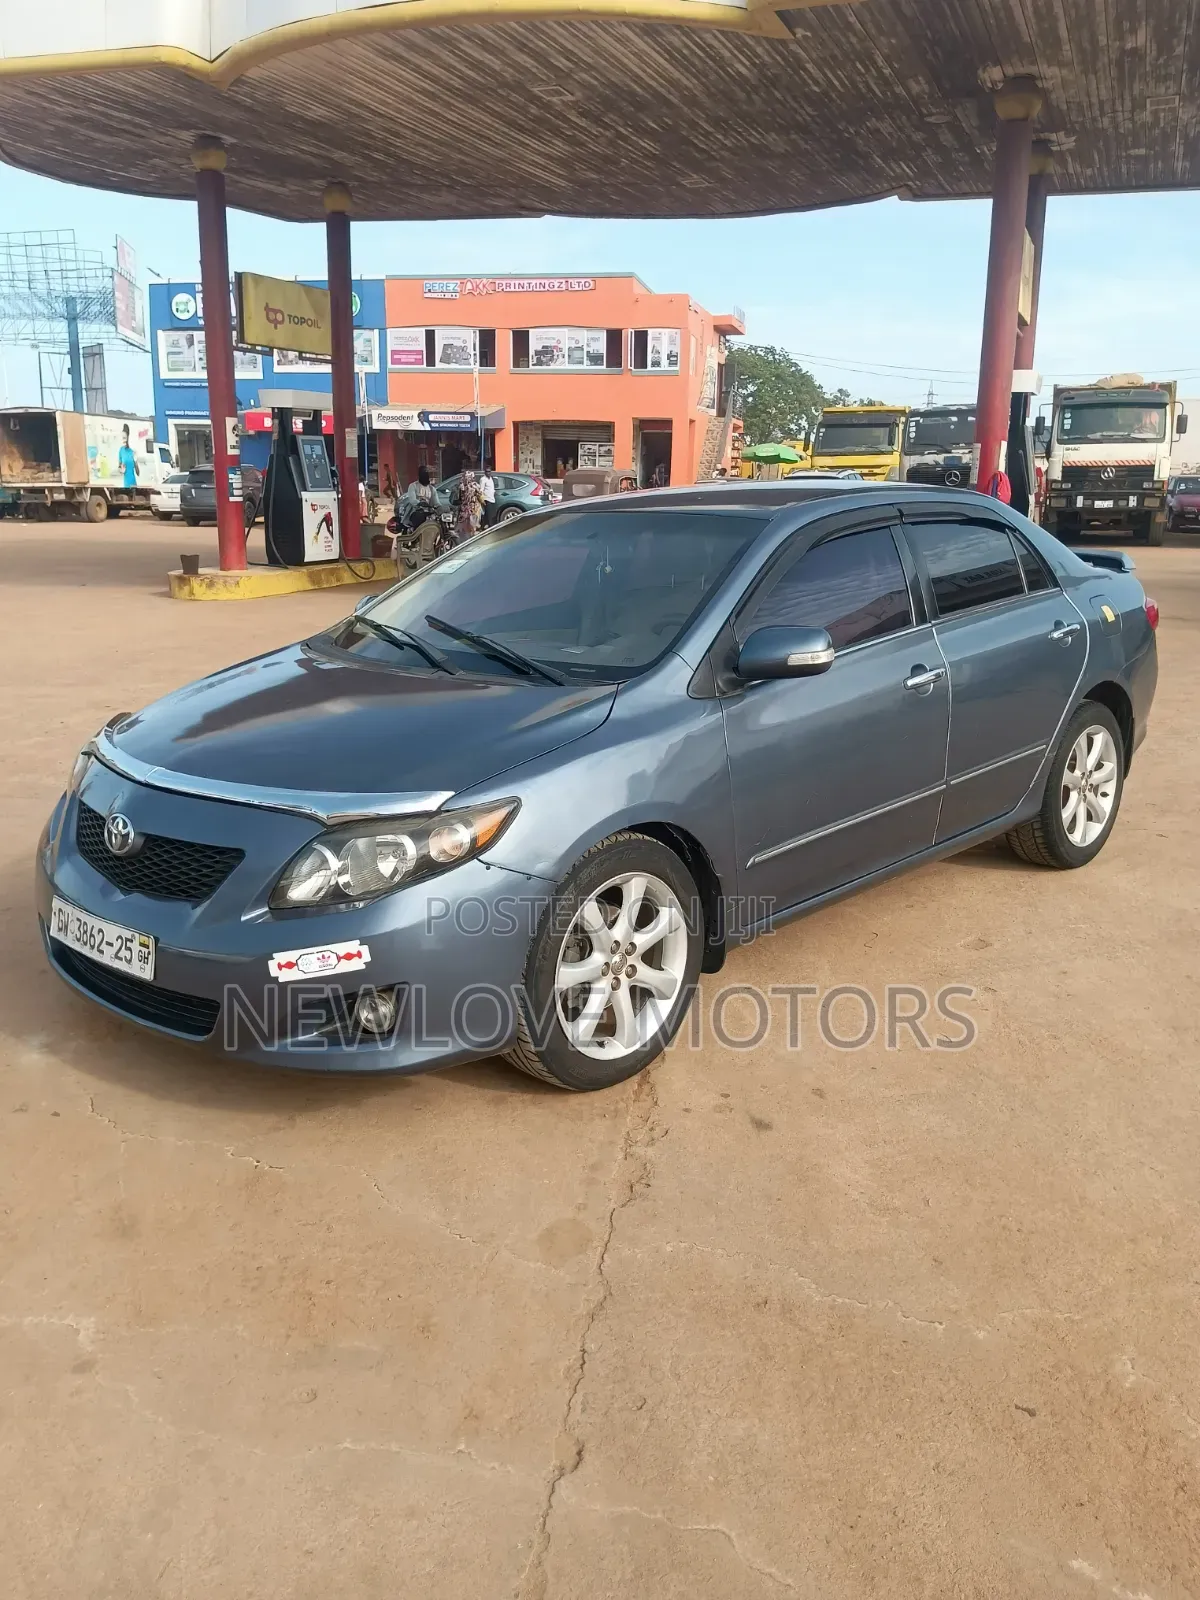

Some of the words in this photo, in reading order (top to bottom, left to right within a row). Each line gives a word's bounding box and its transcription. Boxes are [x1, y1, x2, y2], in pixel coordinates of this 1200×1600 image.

[424, 282, 459, 292] PEREZ
[463, 279, 493, 295] AKK
[497, 281, 564, 292] PRINTINGZ
[569, 280, 592, 289] LTD
[287, 314, 321, 329] TOPOIL
[377, 413, 414, 421] Pepsodent
[76, 917, 134, 965] 3862-25
[138, 949, 150, 966] GH
